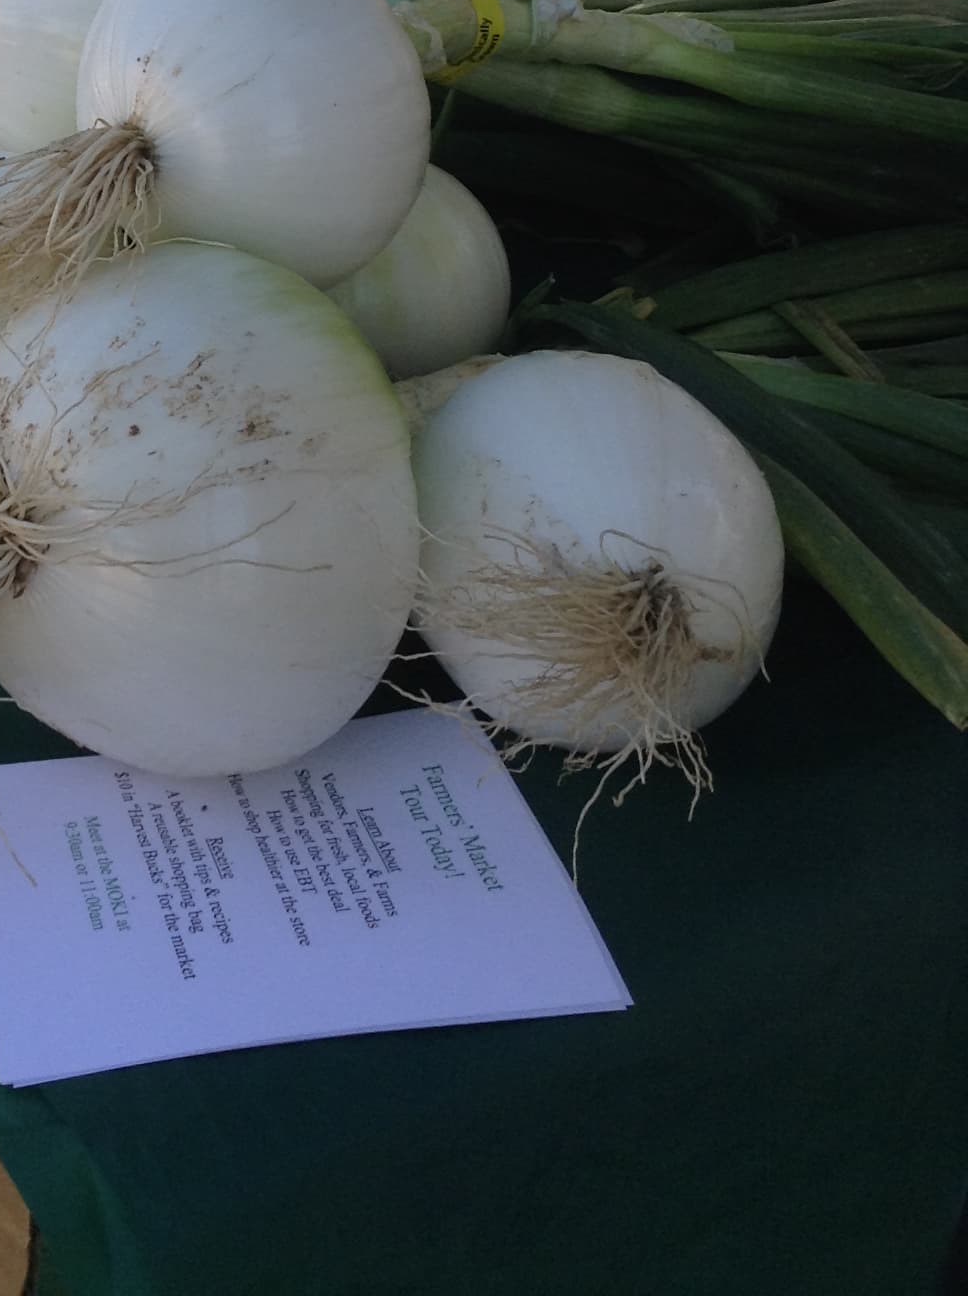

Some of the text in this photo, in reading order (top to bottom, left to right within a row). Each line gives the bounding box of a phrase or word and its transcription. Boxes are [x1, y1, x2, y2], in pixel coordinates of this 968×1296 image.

[113, 771, 133, 790] $10
[83, 815, 103, 843] Meet
[97, 856, 114, 875] the
[204, 836, 234, 879] Receive
[226, 773, 245, 795] How
[242, 809, 261, 833] shop
[254, 835, 283, 880] healthier
[280, 895, 298, 913] the
[289, 916, 310, 946] store
[265, 809, 285, 833] How
[284, 848, 300, 865] use
[292, 867, 318, 894] EBT
[279, 789, 299, 813] How
[294, 828, 315, 844] get
[306, 845, 323, 862] the
[315, 863, 335, 886] best
[327, 888, 351, 913] deal
[294, 768, 324, 817] Shopping
[317, 819, 334, 834] for
[340, 867, 366, 894] local
[354, 896, 380, 929] foods
[355, 806, 402, 873] Learn About
[399, 783, 465, 878] Tour Today!
[74, 863, 88, 876] or
[146, 801, 163, 811] A
[168, 856, 195, 908] shopping
[187, 909, 204, 934] bag
[164, 789, 233, 944] A booklet with tips & recipes
[365, 868, 383, 879] &
[459, 834, 504, 892] Market
[156, 892, 173, 910] for
[163, 912, 180, 933] the
[372, 881, 398, 917] Farms
[170, 935, 197, 980] market
